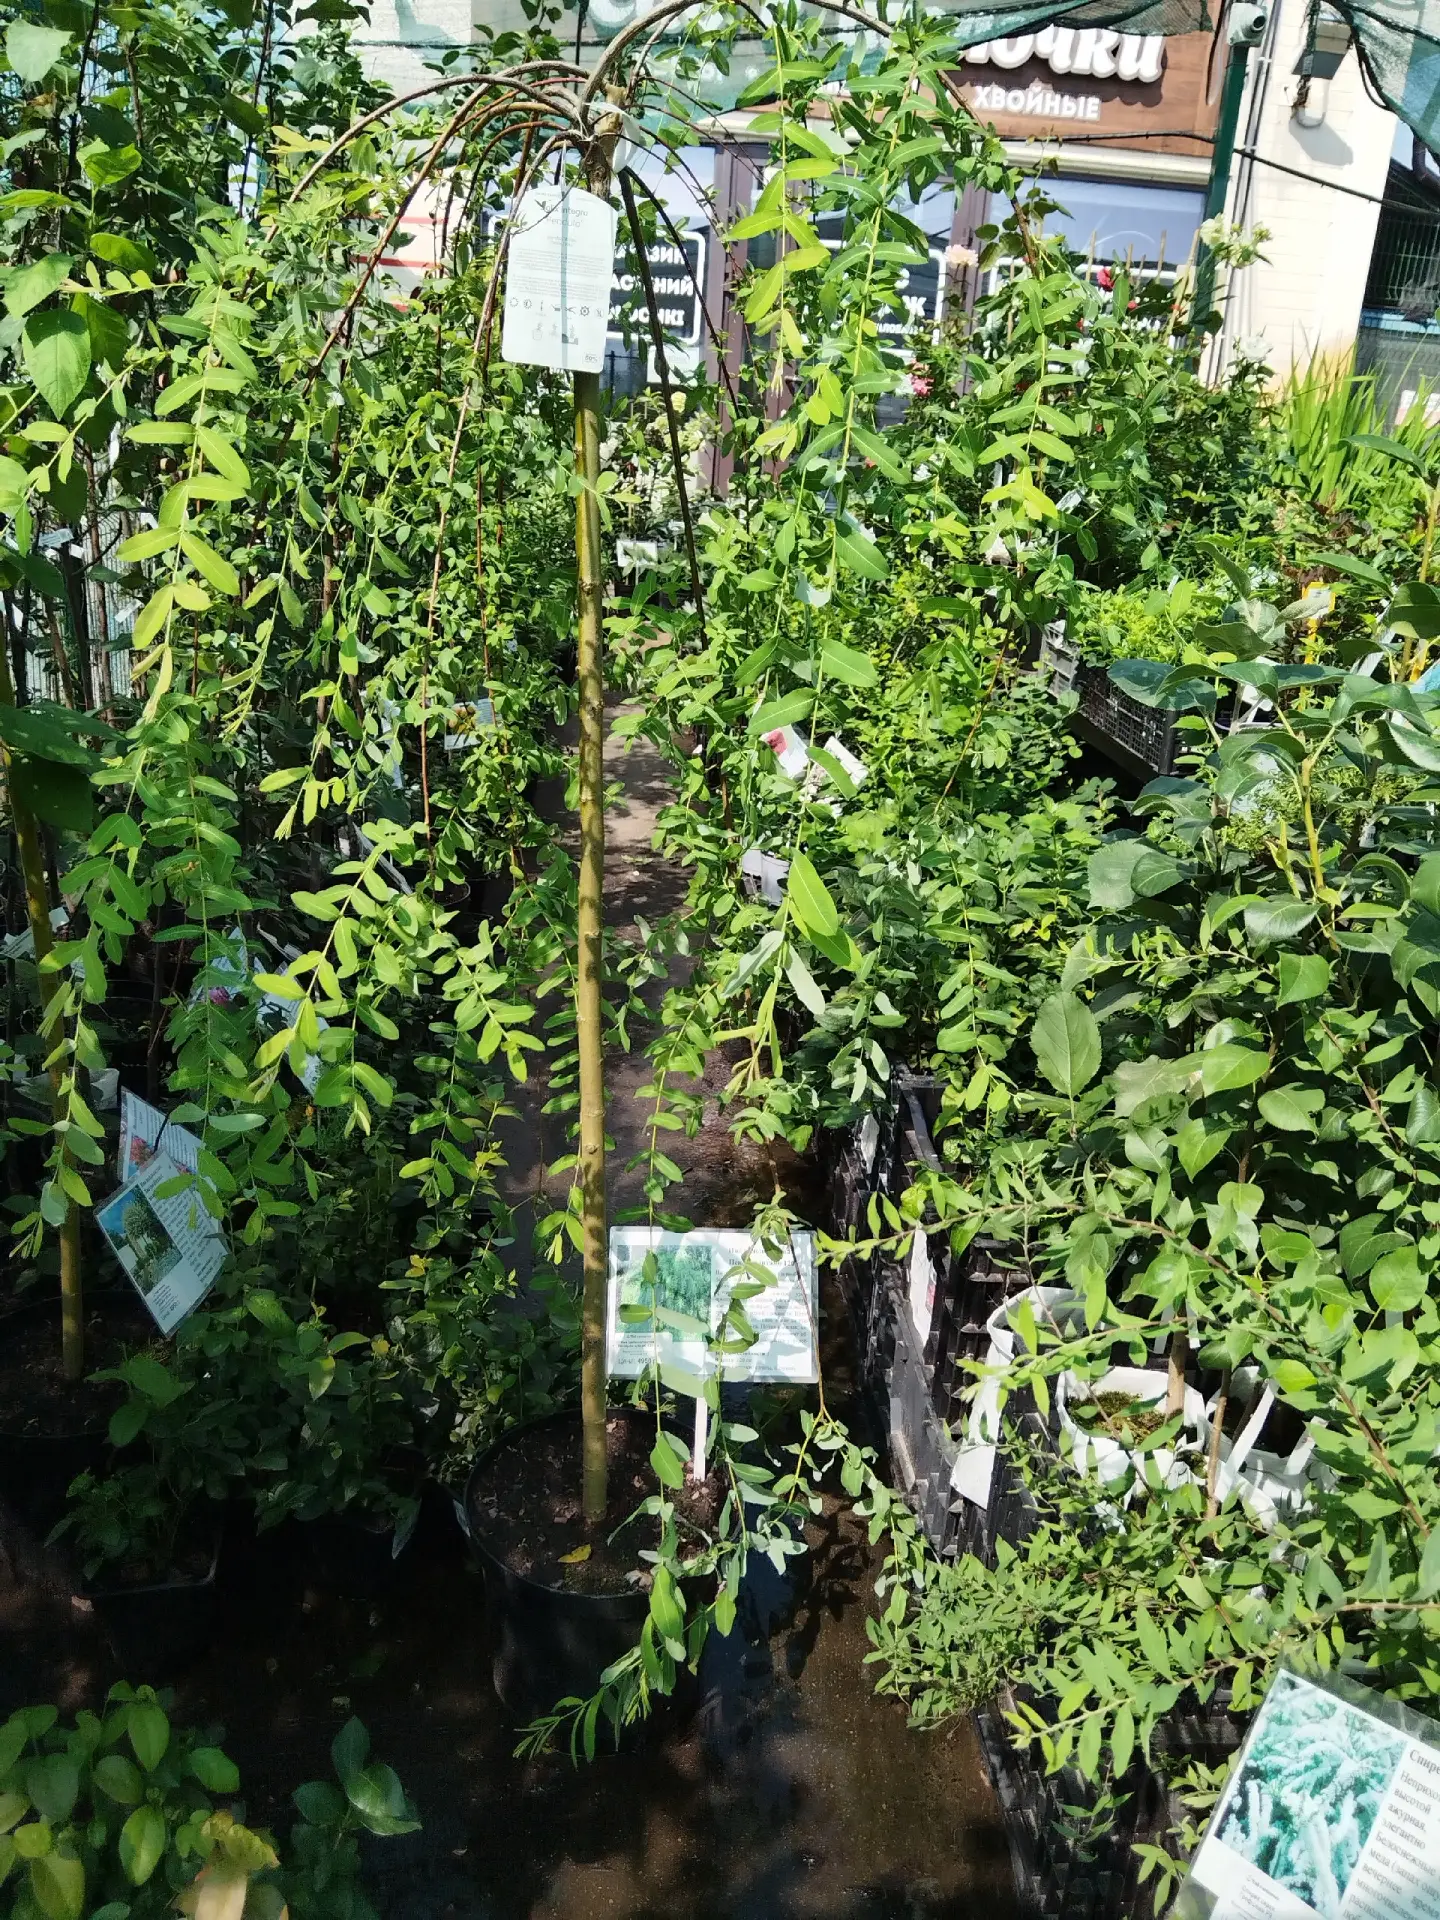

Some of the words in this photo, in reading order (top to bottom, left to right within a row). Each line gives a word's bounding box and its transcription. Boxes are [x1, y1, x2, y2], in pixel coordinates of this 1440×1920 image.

[974, 84, 1101, 121] ХВОЙНЫЕ
[1394, 1788, 1432, 1815] высотой
[1382, 1818, 1426, 1850] элегантно
[1375, 1830, 1437, 1877] Белоснежные
[1362, 1862, 1403, 1895] вечернее
